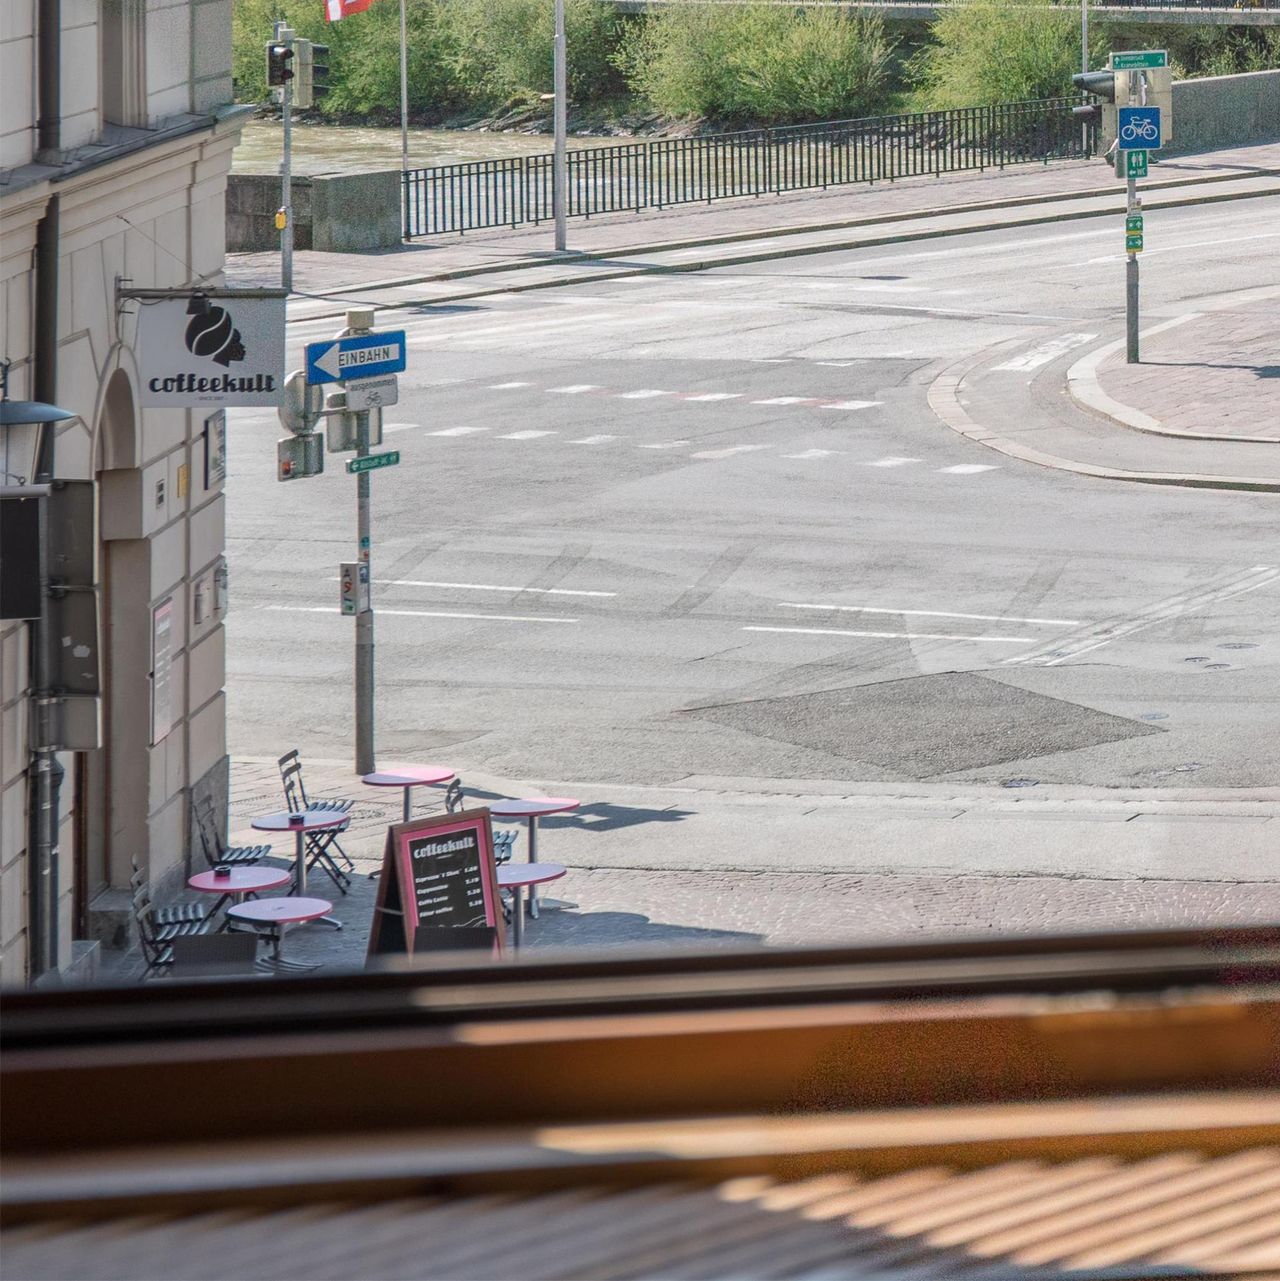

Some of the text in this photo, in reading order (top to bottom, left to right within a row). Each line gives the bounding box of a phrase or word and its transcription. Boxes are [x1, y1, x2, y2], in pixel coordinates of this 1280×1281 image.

[1137, 167, 1146, 176] WC
[338, 347, 390, 367] EINBAHN
[149, 373, 276, 393] coffeekult
[413, 837, 475, 859] coffeekult
